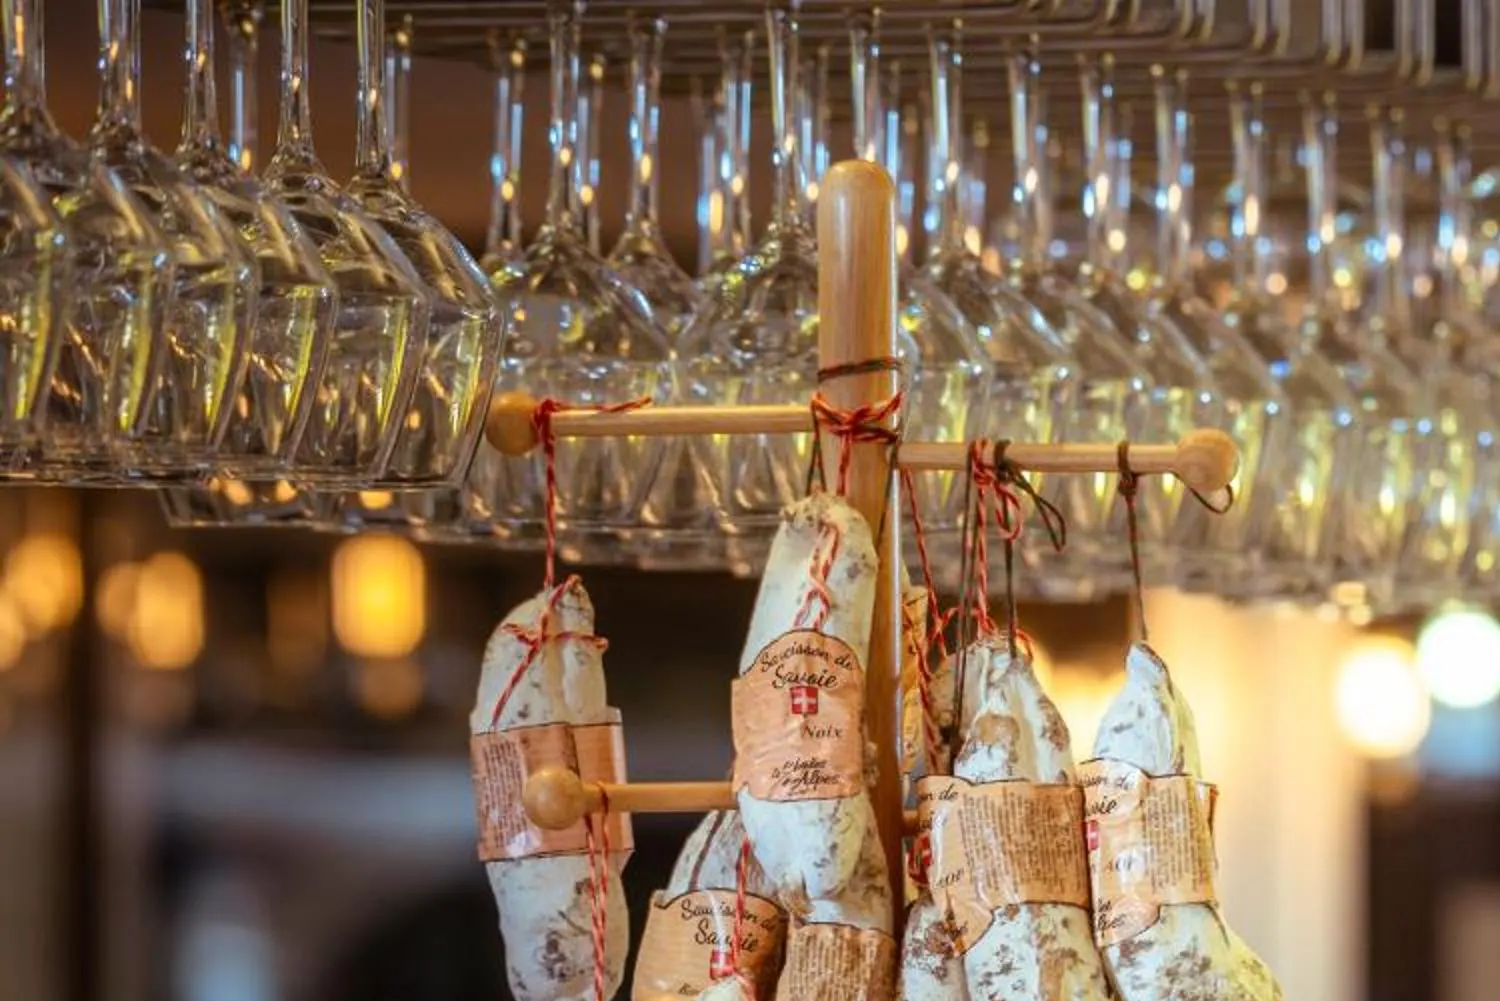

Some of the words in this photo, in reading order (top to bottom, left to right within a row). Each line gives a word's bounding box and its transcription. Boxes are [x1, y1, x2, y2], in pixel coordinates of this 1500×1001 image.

[772, 664, 837, 688] Savoie
[802, 725, 842, 738] Noix
[695, 918, 758, 953] Savie
